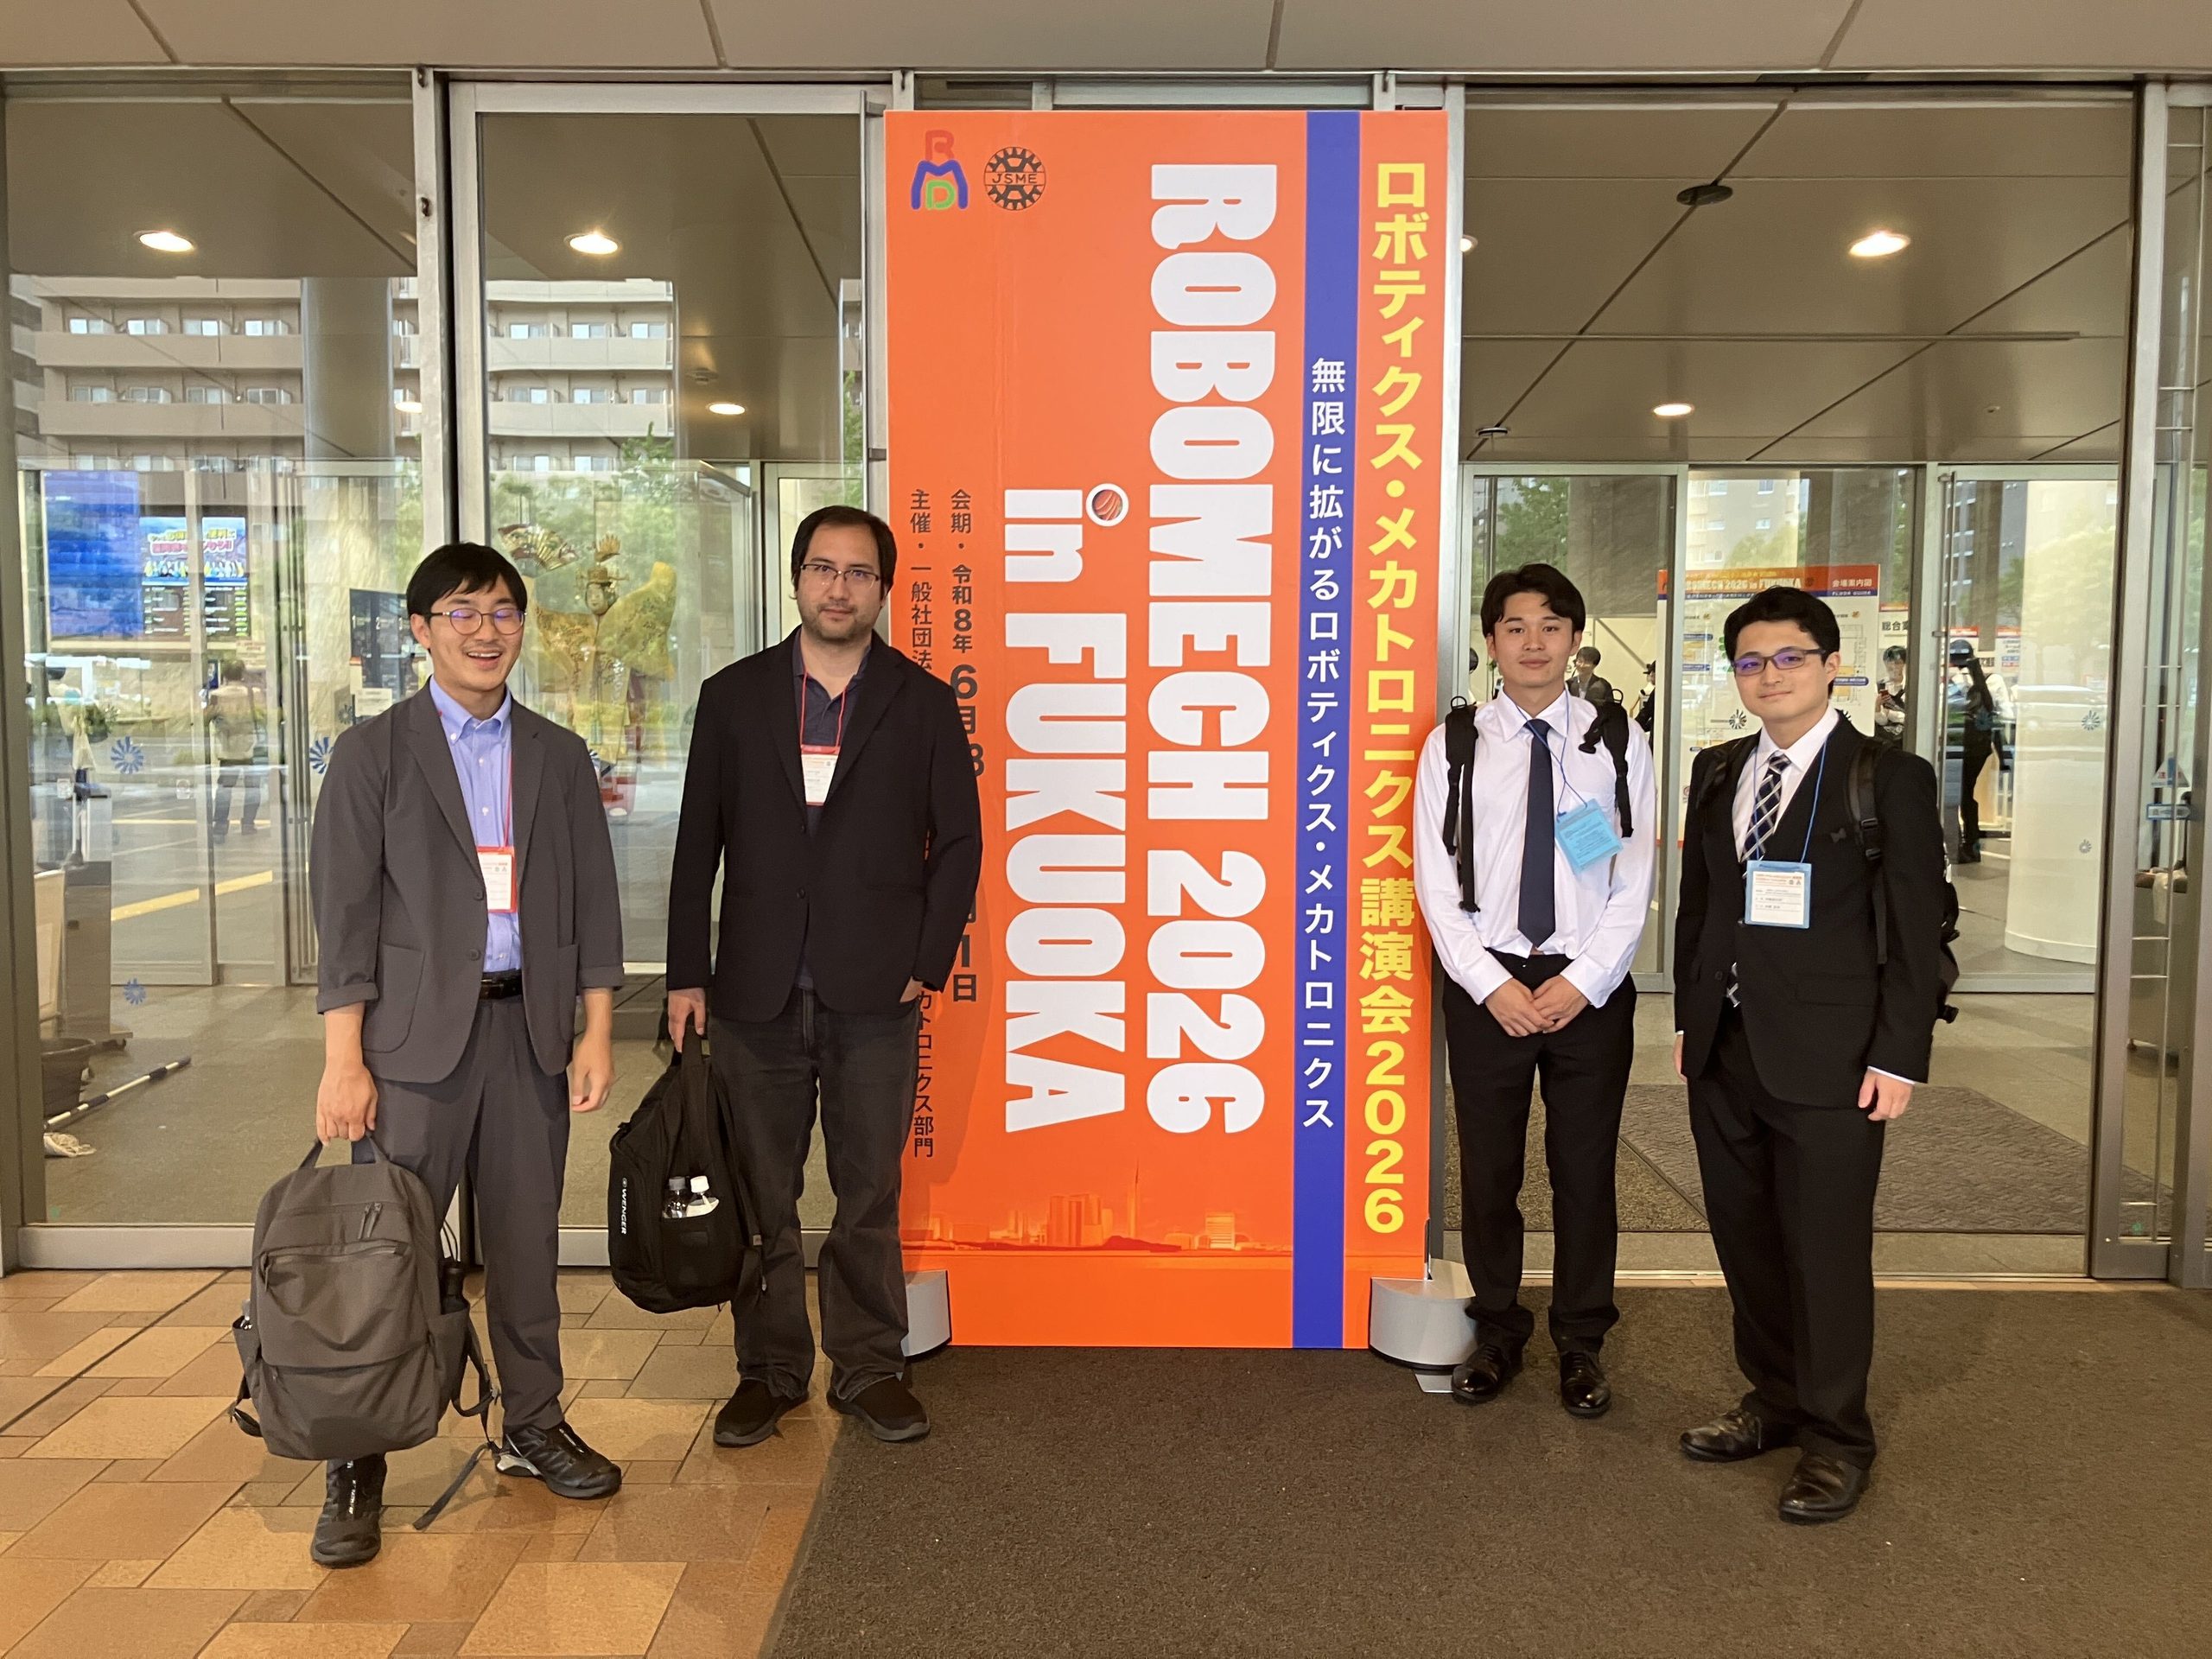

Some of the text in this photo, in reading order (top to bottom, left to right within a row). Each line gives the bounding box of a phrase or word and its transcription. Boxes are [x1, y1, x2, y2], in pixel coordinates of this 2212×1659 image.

[991, 173, 1039, 185] JSME
[1004, 482, 1130, 1134] in FUKUOKA
[1146, 163, 1278, 1135] ROBOMECH 2026
[1302, 357, 1347, 1128] 無限に拡がるロボティクス・メカトロニクス
[1358, 162, 1431, 1235] ロボティクス・メカトロニクス講演会2026
